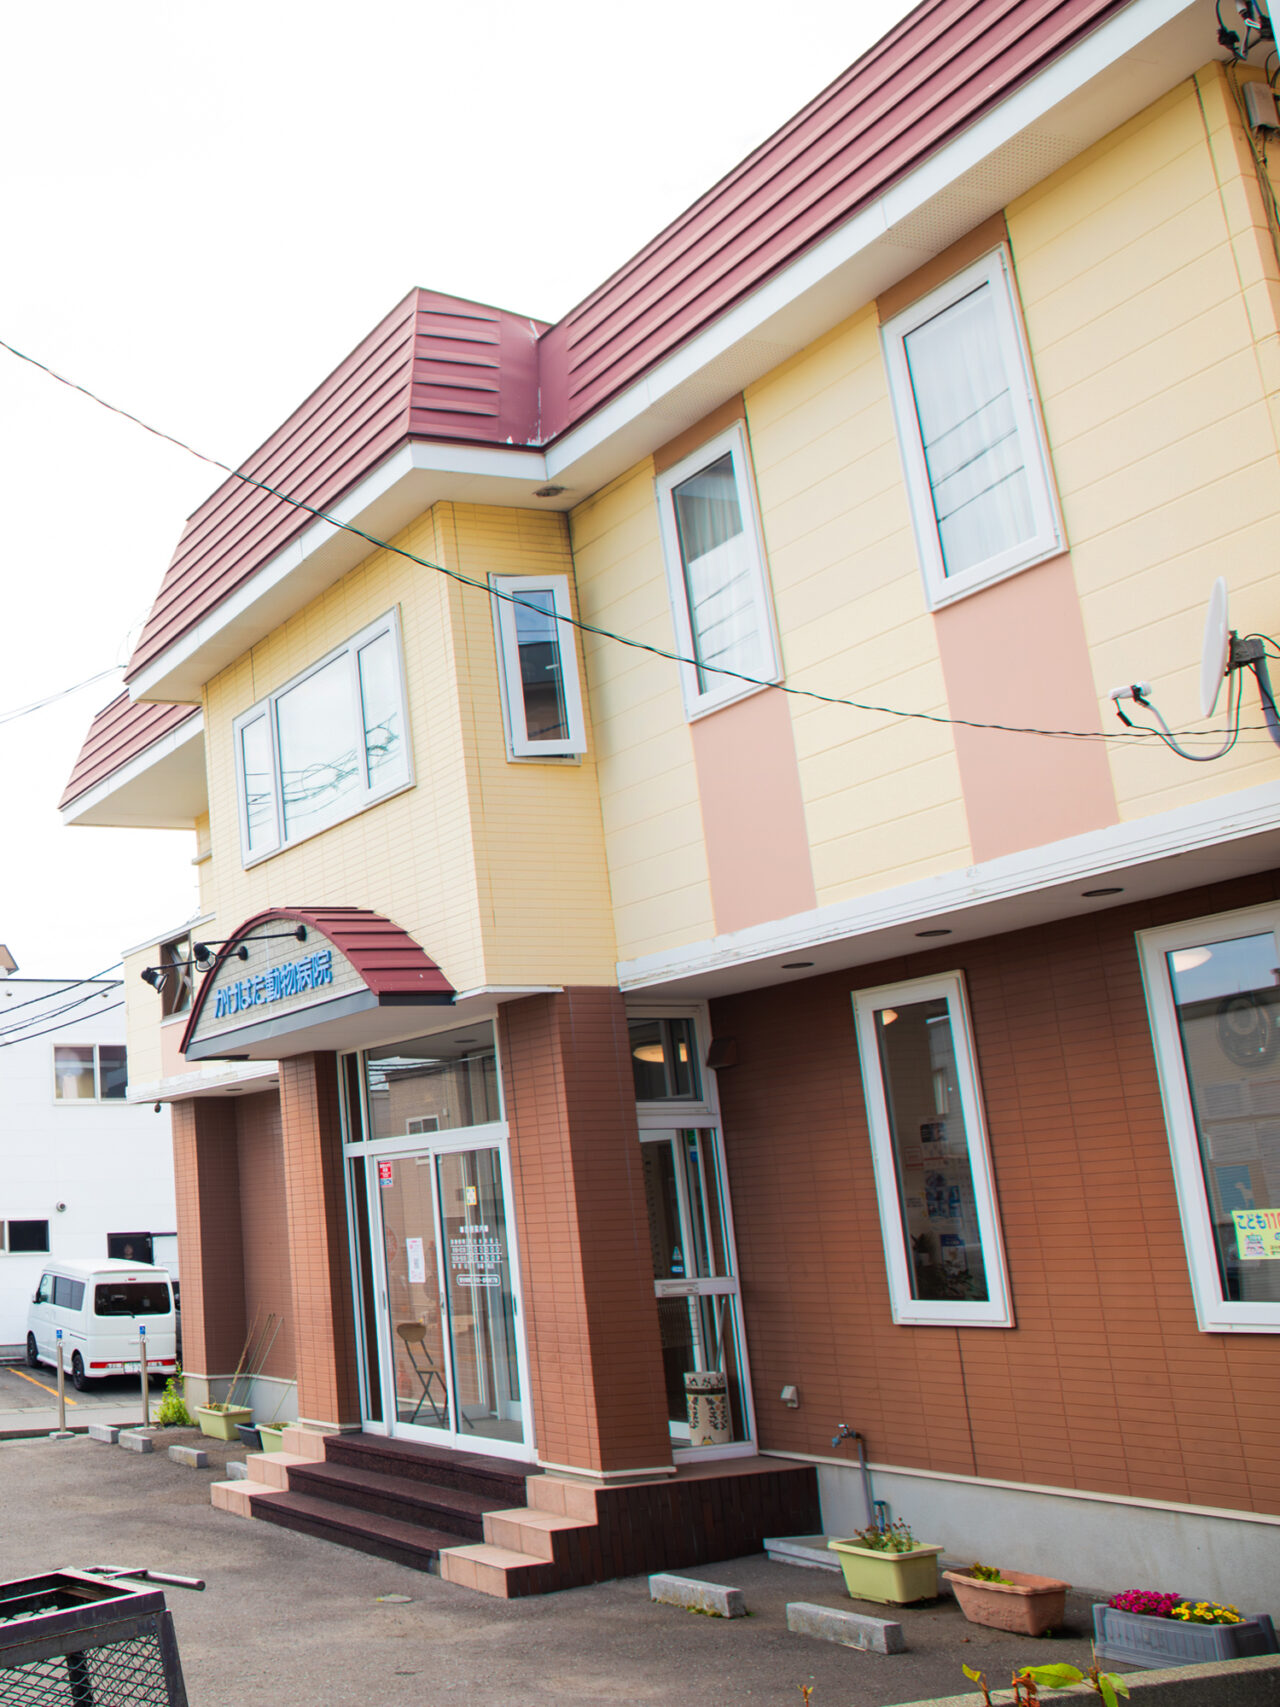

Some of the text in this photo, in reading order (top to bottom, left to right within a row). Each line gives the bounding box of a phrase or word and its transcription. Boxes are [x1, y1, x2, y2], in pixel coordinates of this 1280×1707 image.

[214, 949, 333, 1018] かけはた動物病院
[1236, 1211, 1280, 1230] こども11
